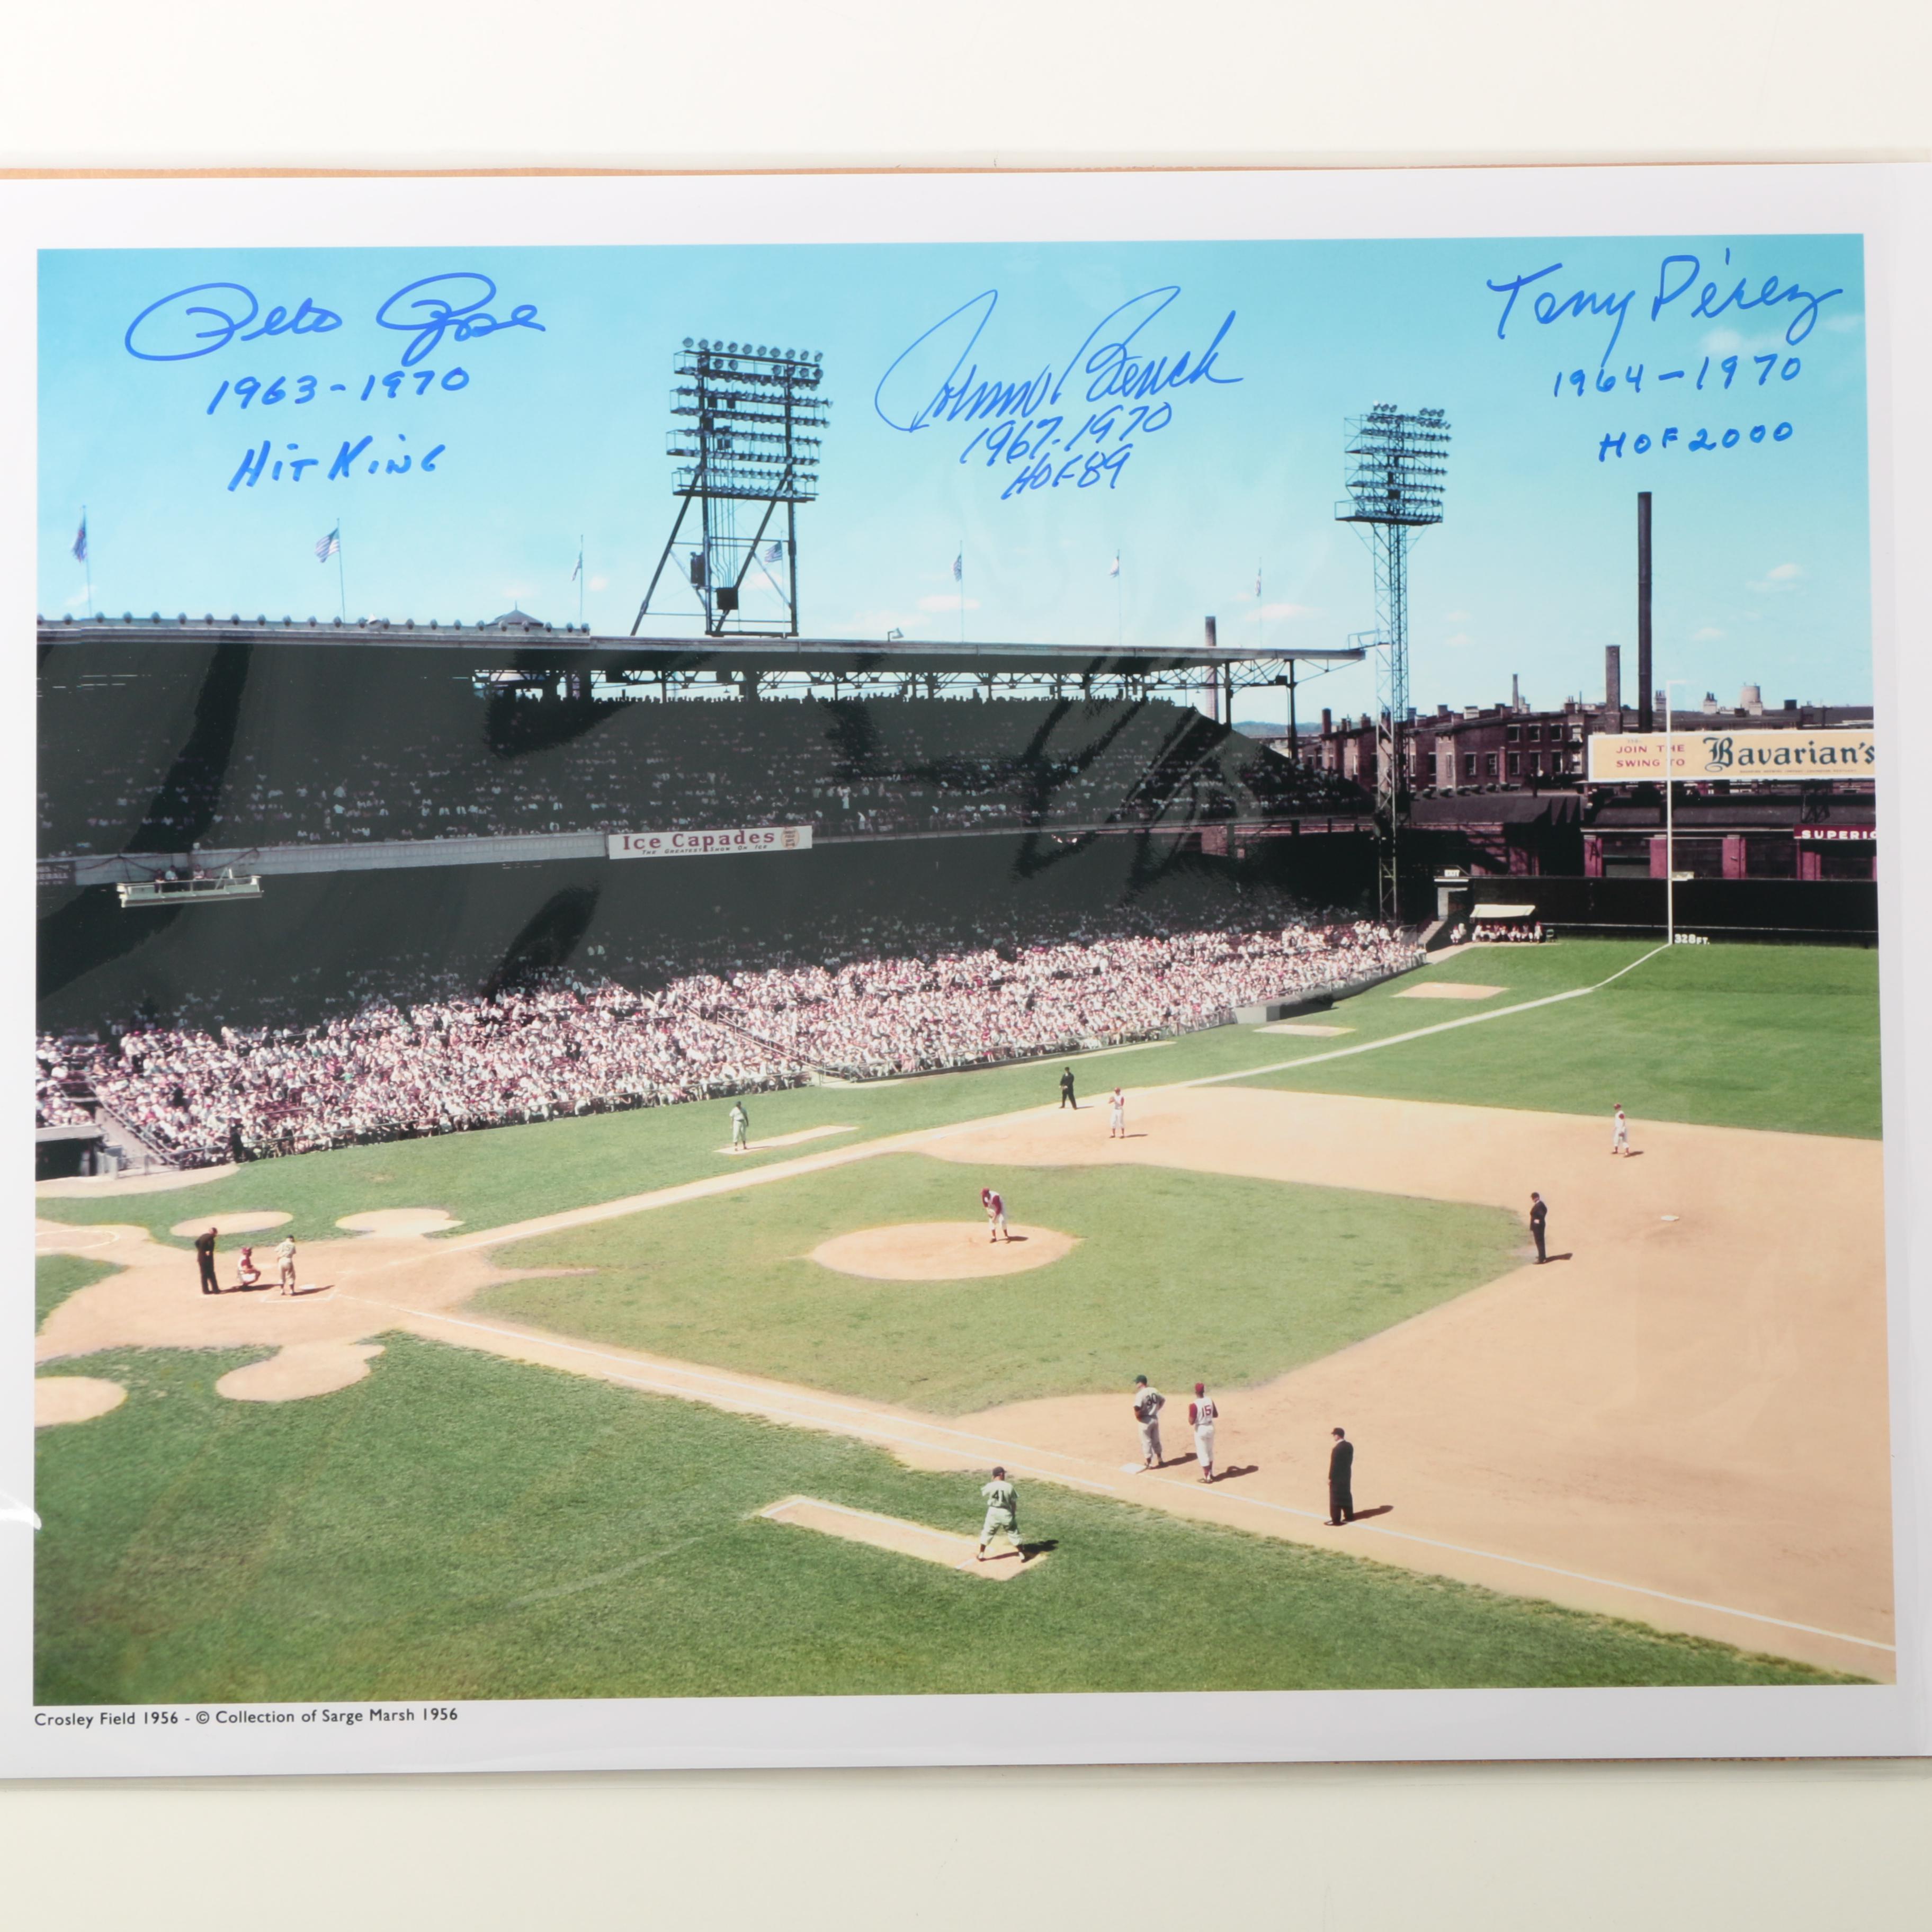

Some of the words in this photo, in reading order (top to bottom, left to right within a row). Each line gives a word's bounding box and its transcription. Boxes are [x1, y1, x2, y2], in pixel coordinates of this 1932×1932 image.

[1486, 262, 1636, 368] Tony
[1616, 759, 1660, 767] SWING
[1702, 737, 1875, 773] Bavarian's
[623, 835, 661, 850] Ice
[672, 829, 775, 853] Capades
[1201, 1405, 1212, 1417] 15
[992, 1489, 1005, 1502] 41
[34, 1713, 94, 1729] Crosley
[100, 1712, 136, 1725] Field
[144, 1711, 178, 1724] 1956
[216, 1710, 294, 1723] Collection
[301, 1709, 317, 1722] of
[322, 1709, 363, 1725] Sarge
[370, 1709, 415, 1721] Marsh
[424, 1708, 458, 1721] 1956
